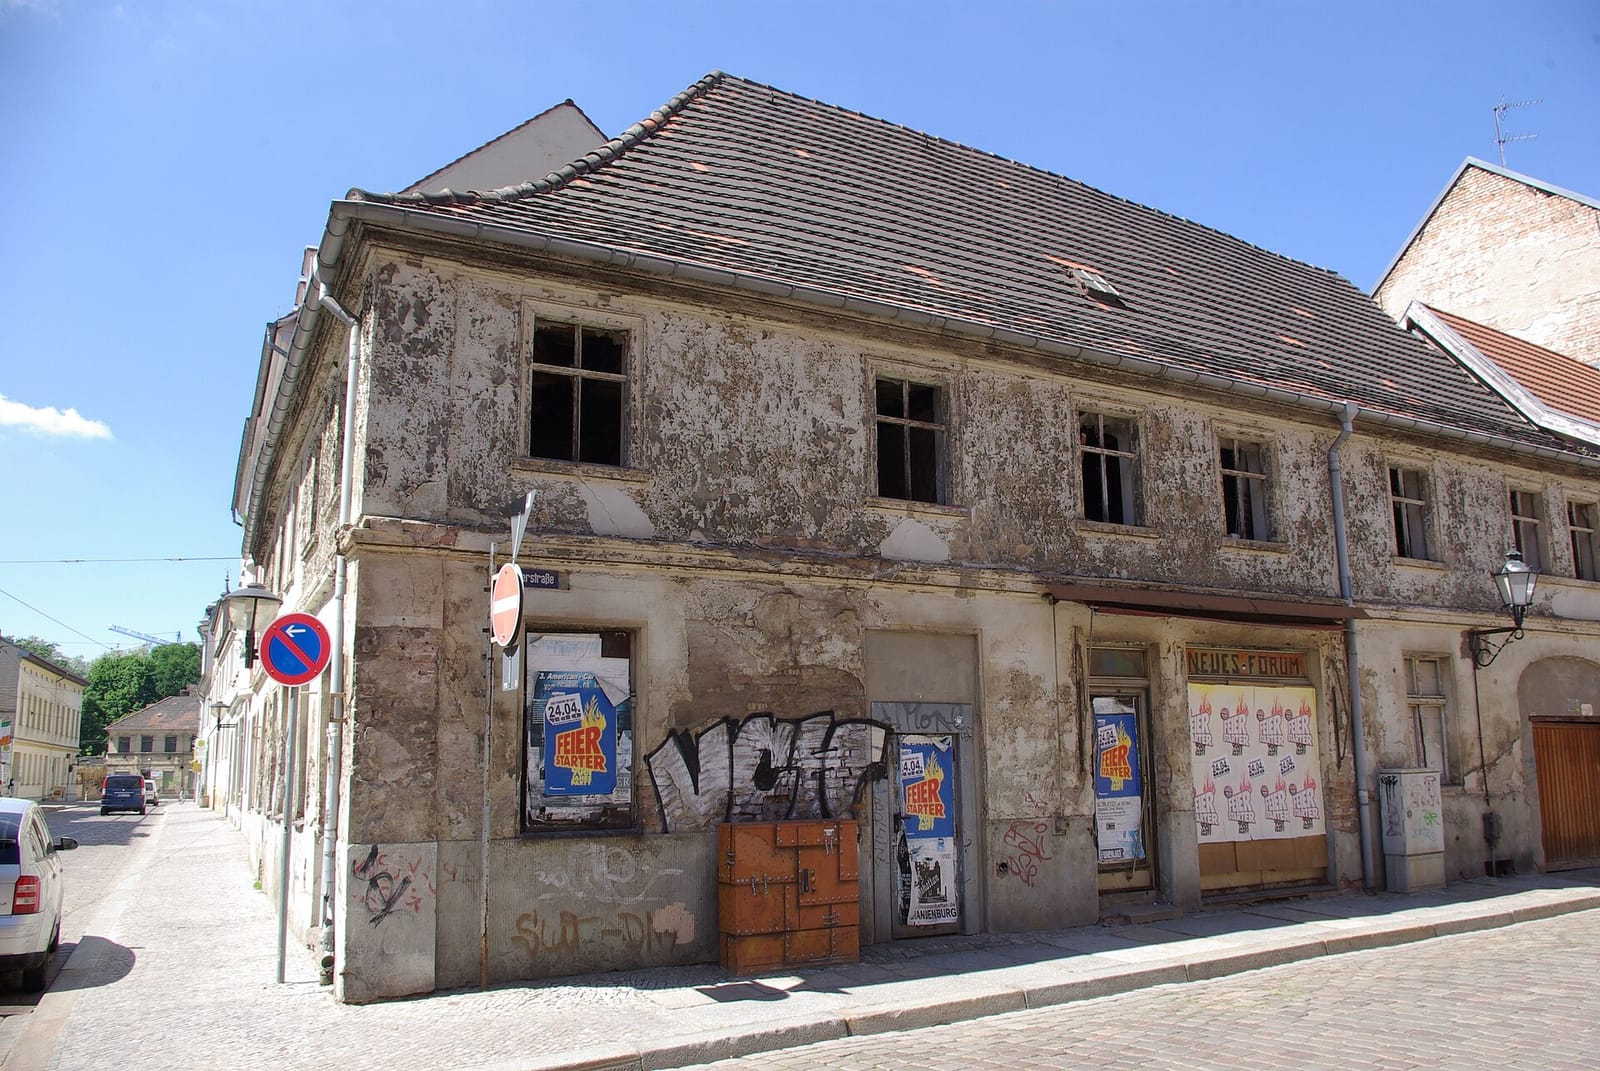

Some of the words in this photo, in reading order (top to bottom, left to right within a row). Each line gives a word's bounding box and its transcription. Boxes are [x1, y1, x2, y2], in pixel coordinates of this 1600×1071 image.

[1187, 652, 1240, 674] NEUES
[1248, 655, 1300, 675] FORUM
[548, 702, 580, 718] 24.04.
[557, 726, 602, 754] FEIER
[556, 755, 606, 770] STARTER
[1102, 745, 1128, 767] FEIER
[907, 778, 939, 803] FEIER
[907, 803, 944, 817] STARTER
